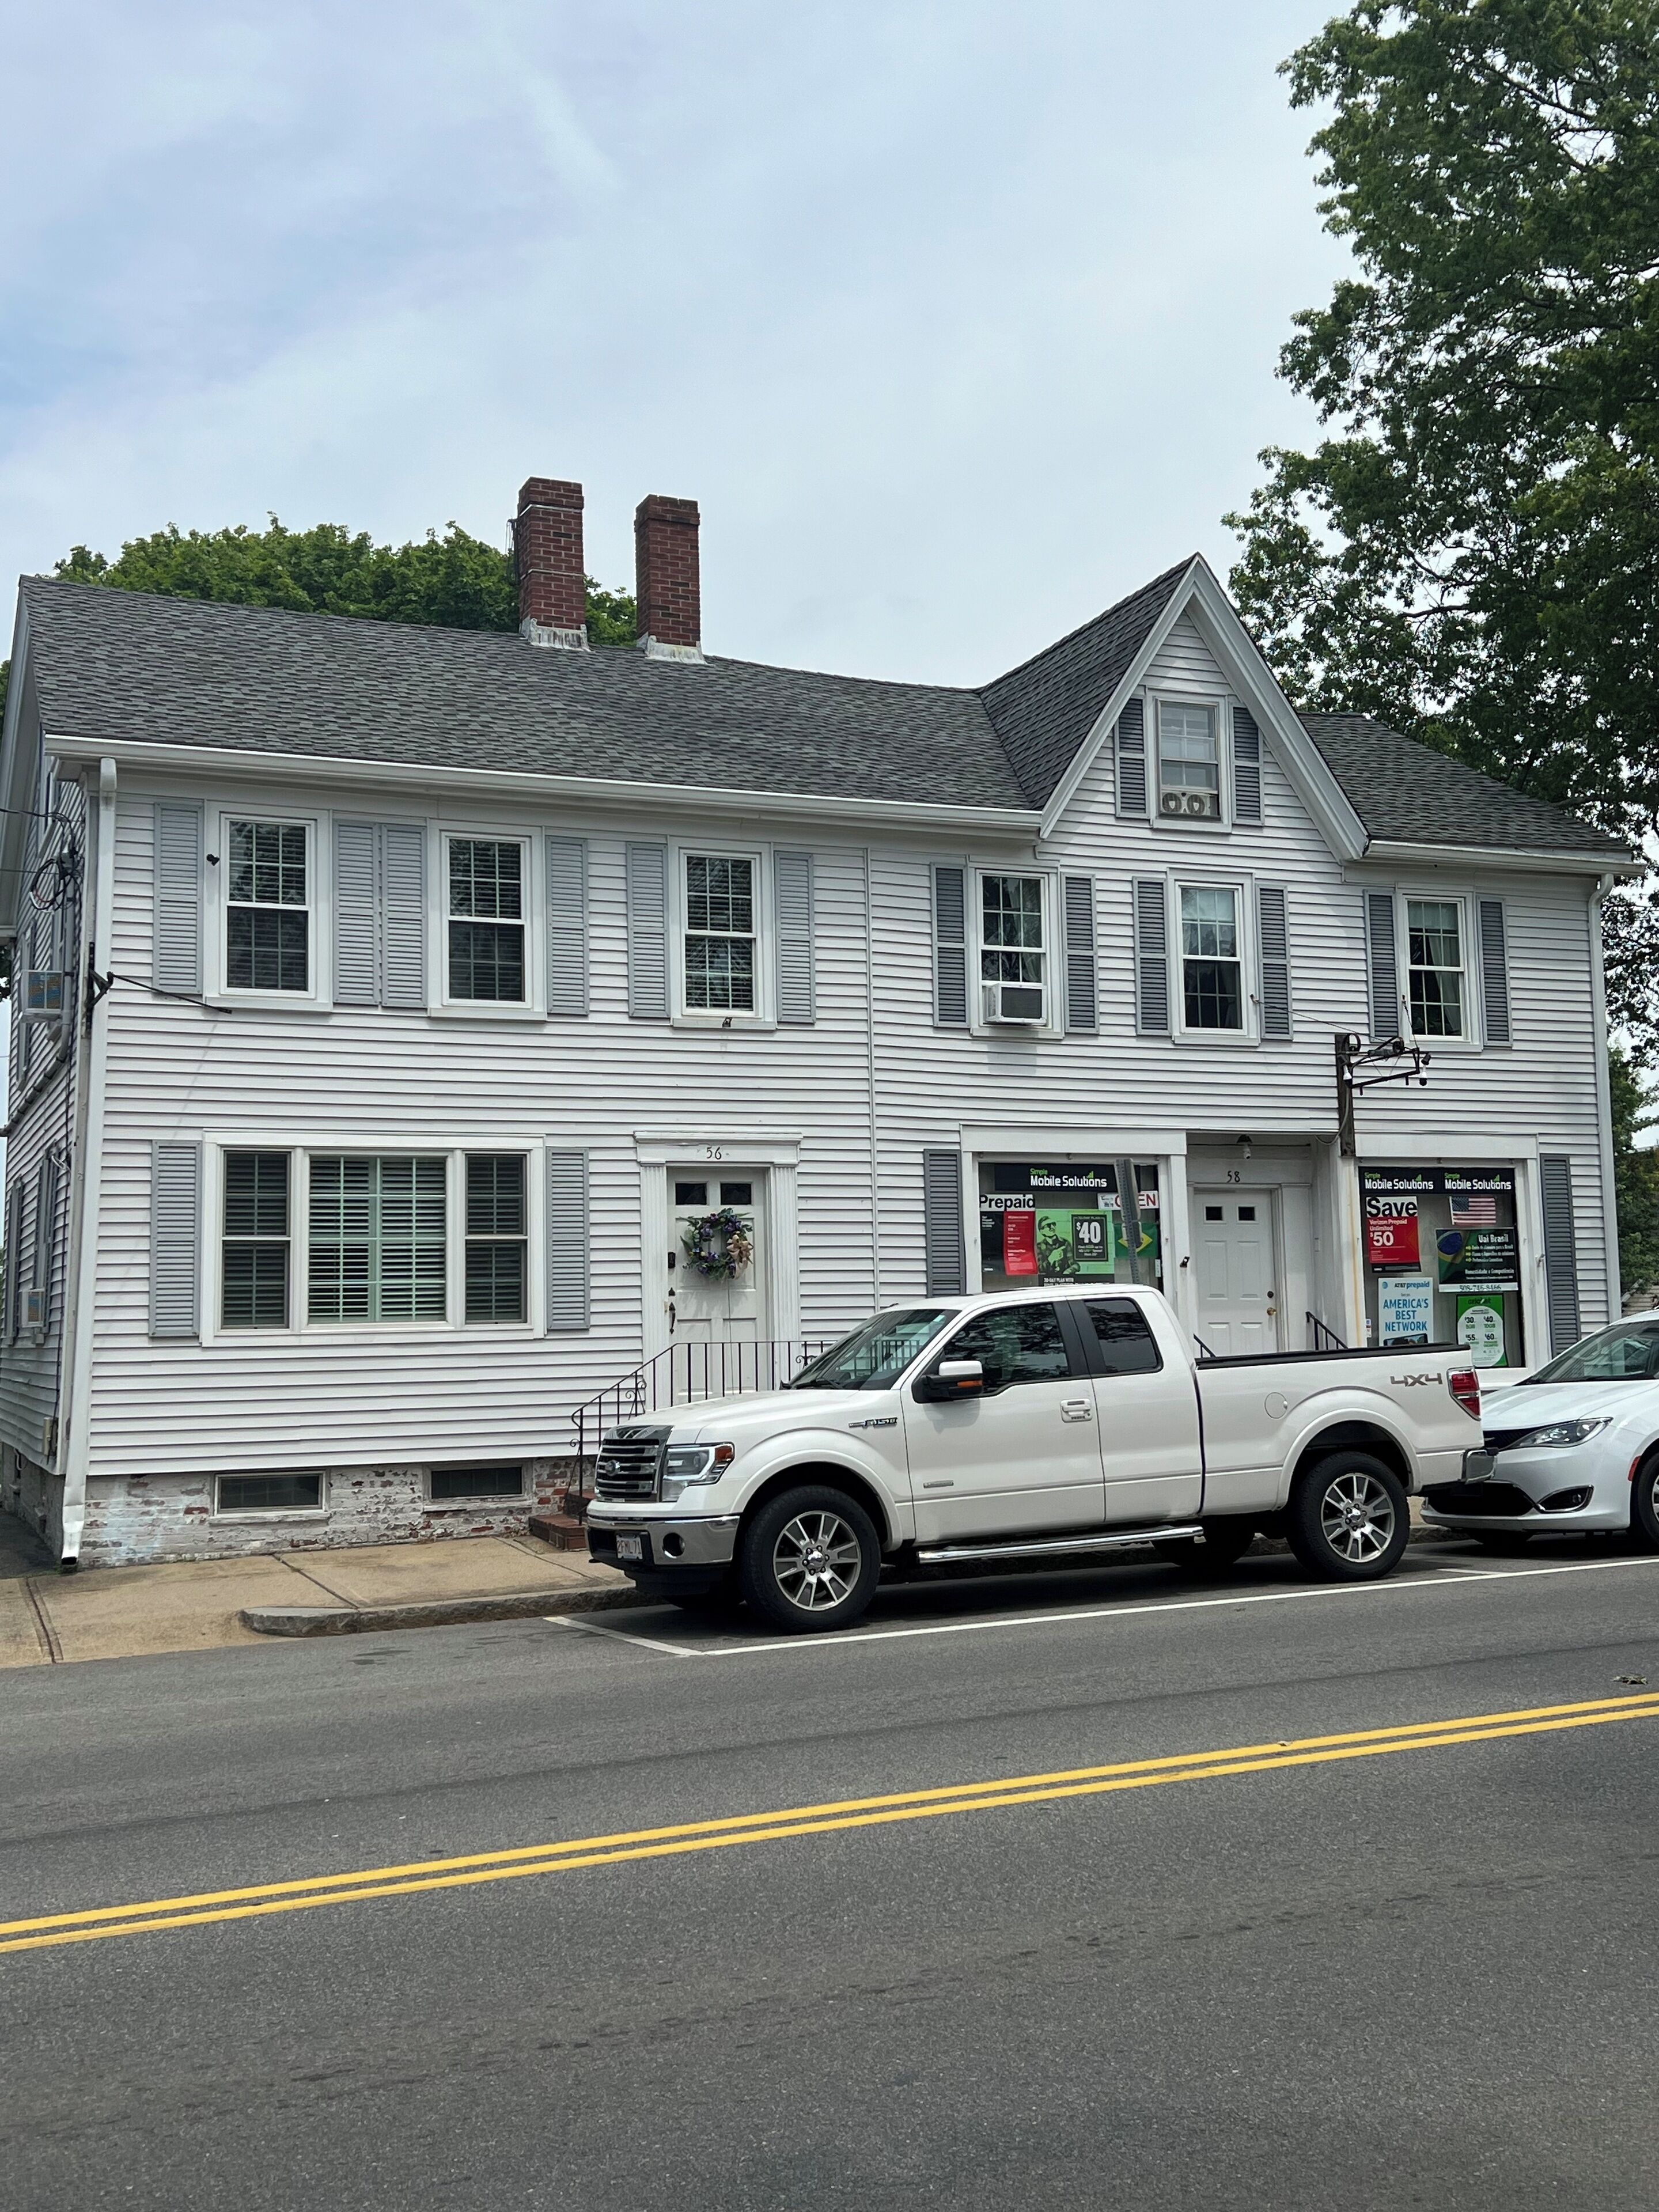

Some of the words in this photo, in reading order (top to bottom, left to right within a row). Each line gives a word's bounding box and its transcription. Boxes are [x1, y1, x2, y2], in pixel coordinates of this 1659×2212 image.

[706, 1146, 722, 1160] 56
[1030, 1175, 1061, 1186] Mobile
[1062, 1176, 1107, 1187] Solutions
[1226, 1170, 1240, 1183] 58
[1365, 1179, 1393, 1190] Mobile
[1393, 1179, 1434, 1190] Solutions
[1445, 1179, 1472, 1190] Mobile
[1472, 1179, 1512, 1190] Solutions
[979, 1194, 1035, 1211] Prepaid
[1366, 1196, 1418, 1218] Save
[1076, 1222, 1101, 1243] $40
[1370, 1232, 1394, 1247] $50
[1490, 1234, 1509, 1243] Brasil
[1406, 1281, 1430, 1289] prepaid
[1383, 1298, 1429, 1309] AMERICA'S
[1396, 1310, 1416, 1320] BEST
[1385, 1321, 1427, 1332] NETWORK
